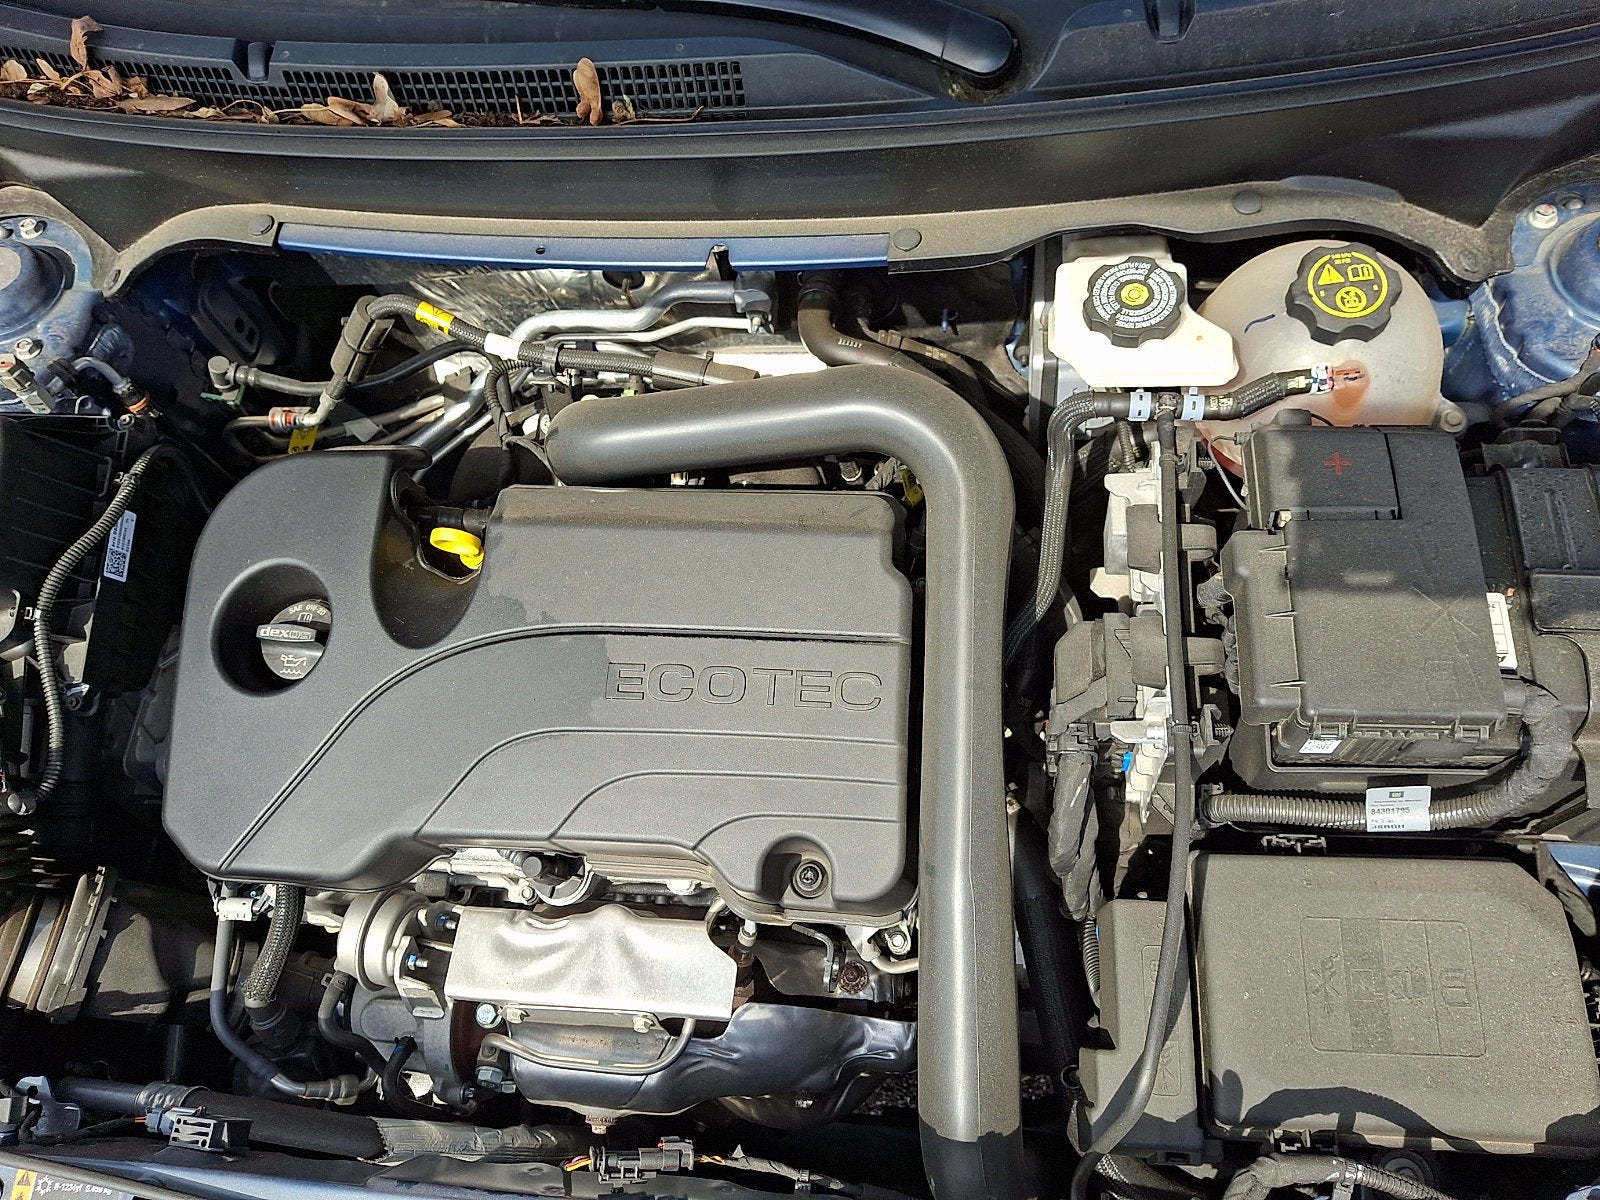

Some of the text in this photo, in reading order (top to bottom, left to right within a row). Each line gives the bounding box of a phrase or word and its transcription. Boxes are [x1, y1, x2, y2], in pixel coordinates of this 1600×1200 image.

[288, 604, 327, 616] SAE 0W-20
[259, 626, 312, 639] dexos
[605, 662, 882, 711] ECOTEC
